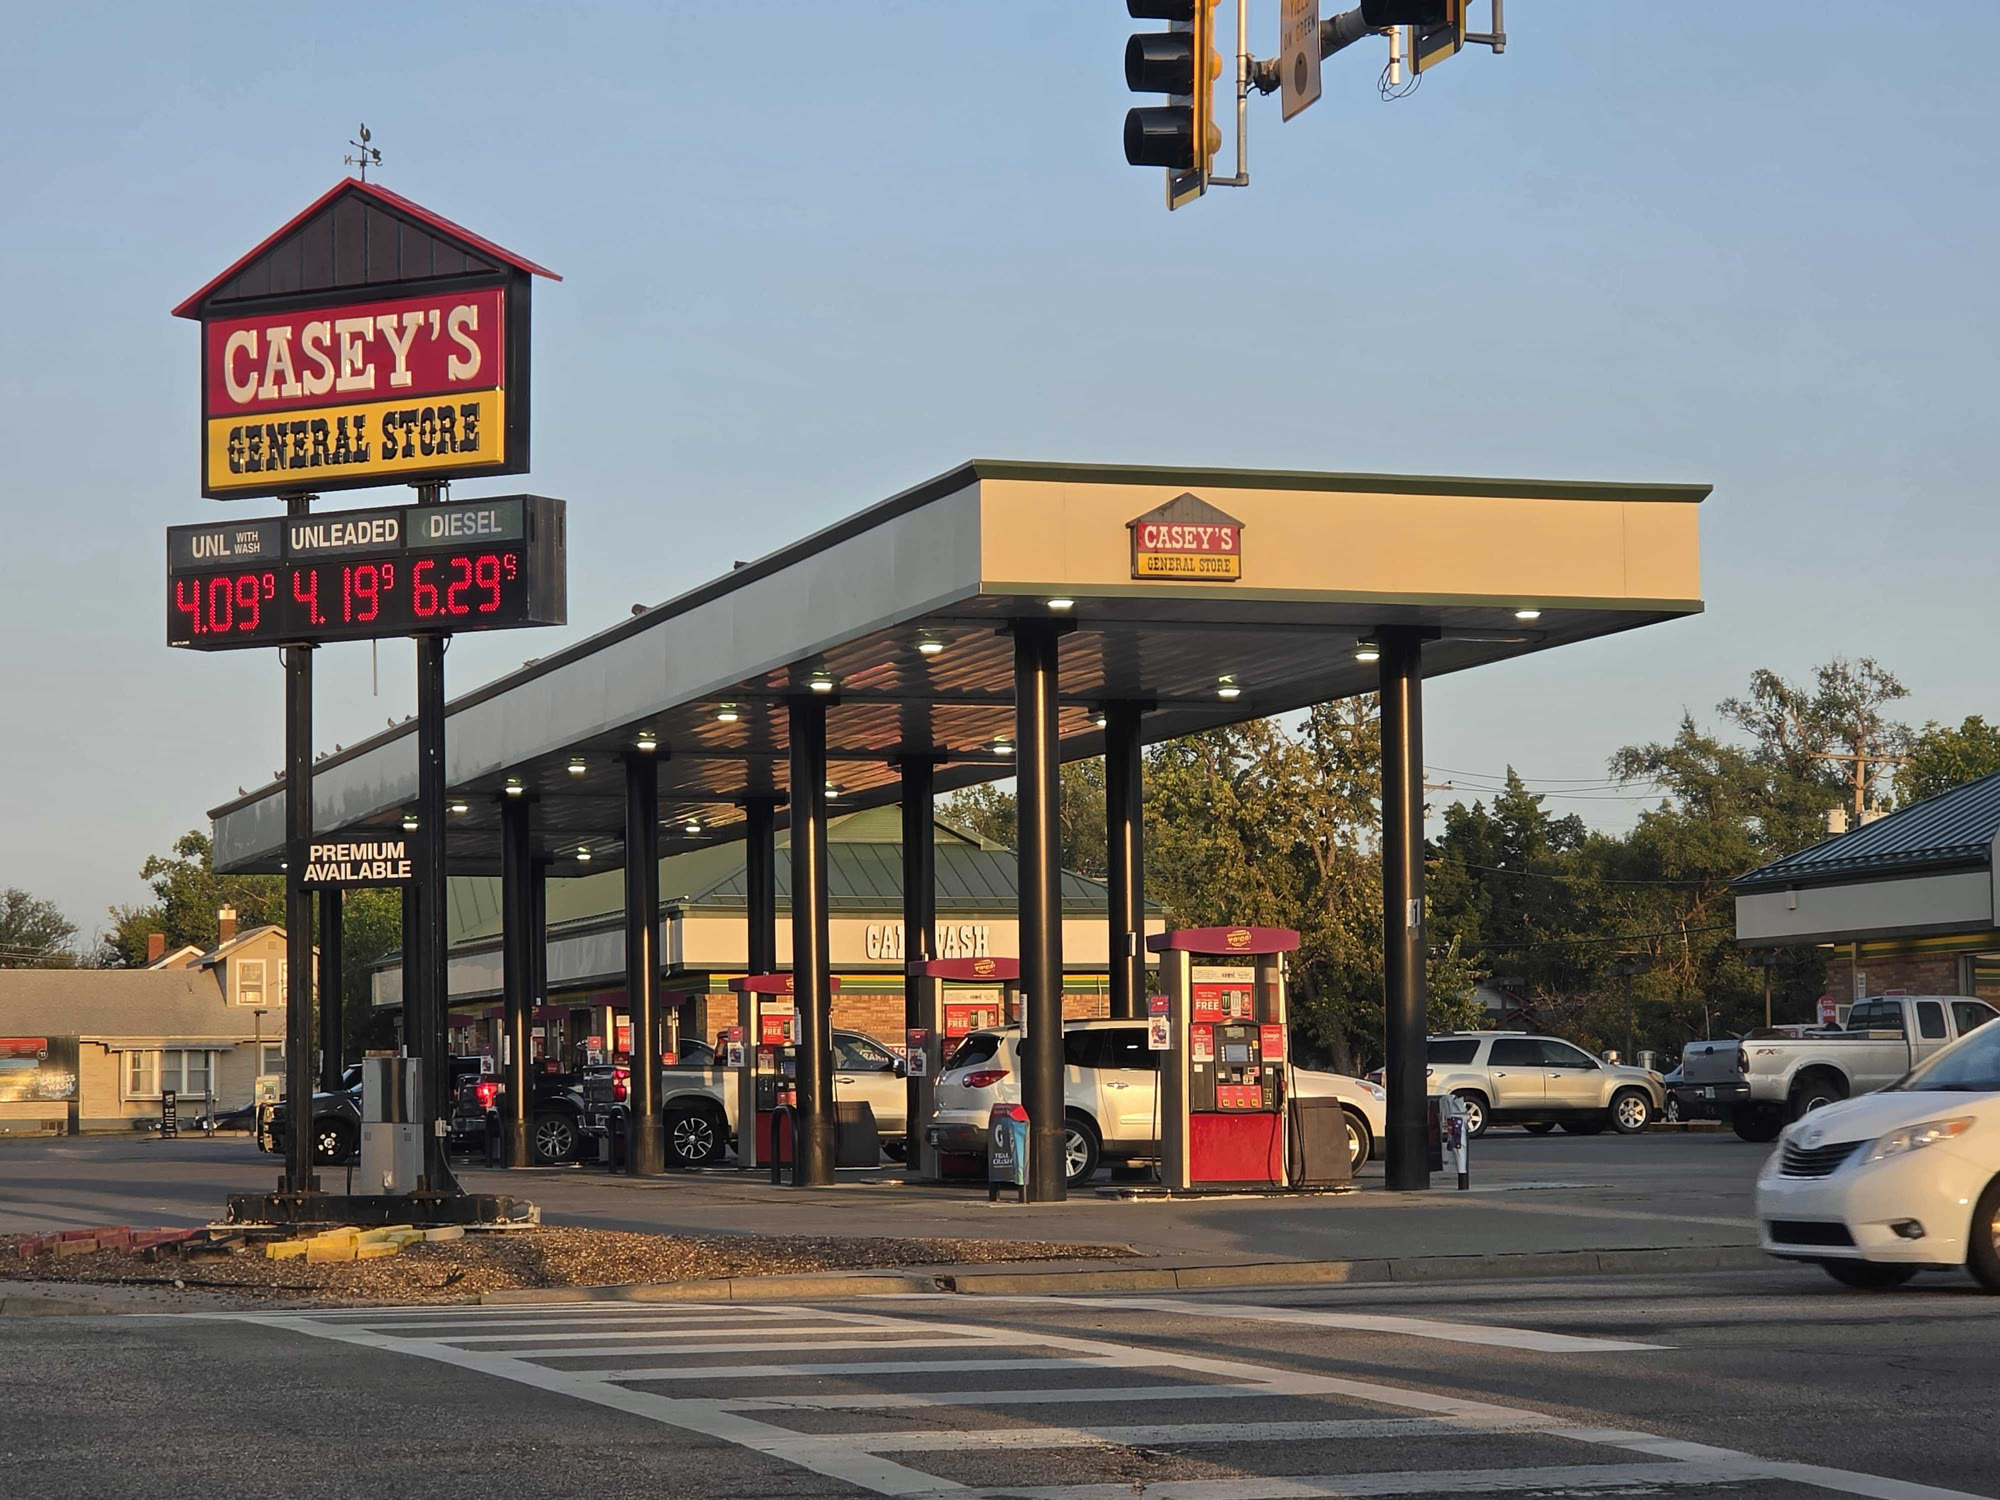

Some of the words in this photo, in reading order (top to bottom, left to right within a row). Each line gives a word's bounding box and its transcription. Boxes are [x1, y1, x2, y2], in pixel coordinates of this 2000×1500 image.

[1283, 31, 1292, 51] ON
[1296, 13, 1316, 42] GREEN
[224, 304, 481, 403] CASEY'S
[227, 414, 371, 474] GENERAL
[382, 402, 480, 460] STORE
[291, 518, 398, 550] UNLEADED
[430, 510, 502, 538] DIESEL
[192, 534, 231, 558] UNL
[236, 531, 259, 543] WITH
[1144, 525, 1233, 550] CASEY'S
[234, 542, 260, 555] WASH
[1147, 557, 1195, 572] GENERAL
[1199, 558, 1231, 573] STORE
[310, 842, 405, 862] PREMIUM
[303, 860, 412, 881] AVAILABLE
[1195, 1001, 1219, 1011] FREE
[763, 1028, 781, 1036] FREE
[947, 1020, 968, 1029] FREE
[47, 1082, 73, 1091] WASH
